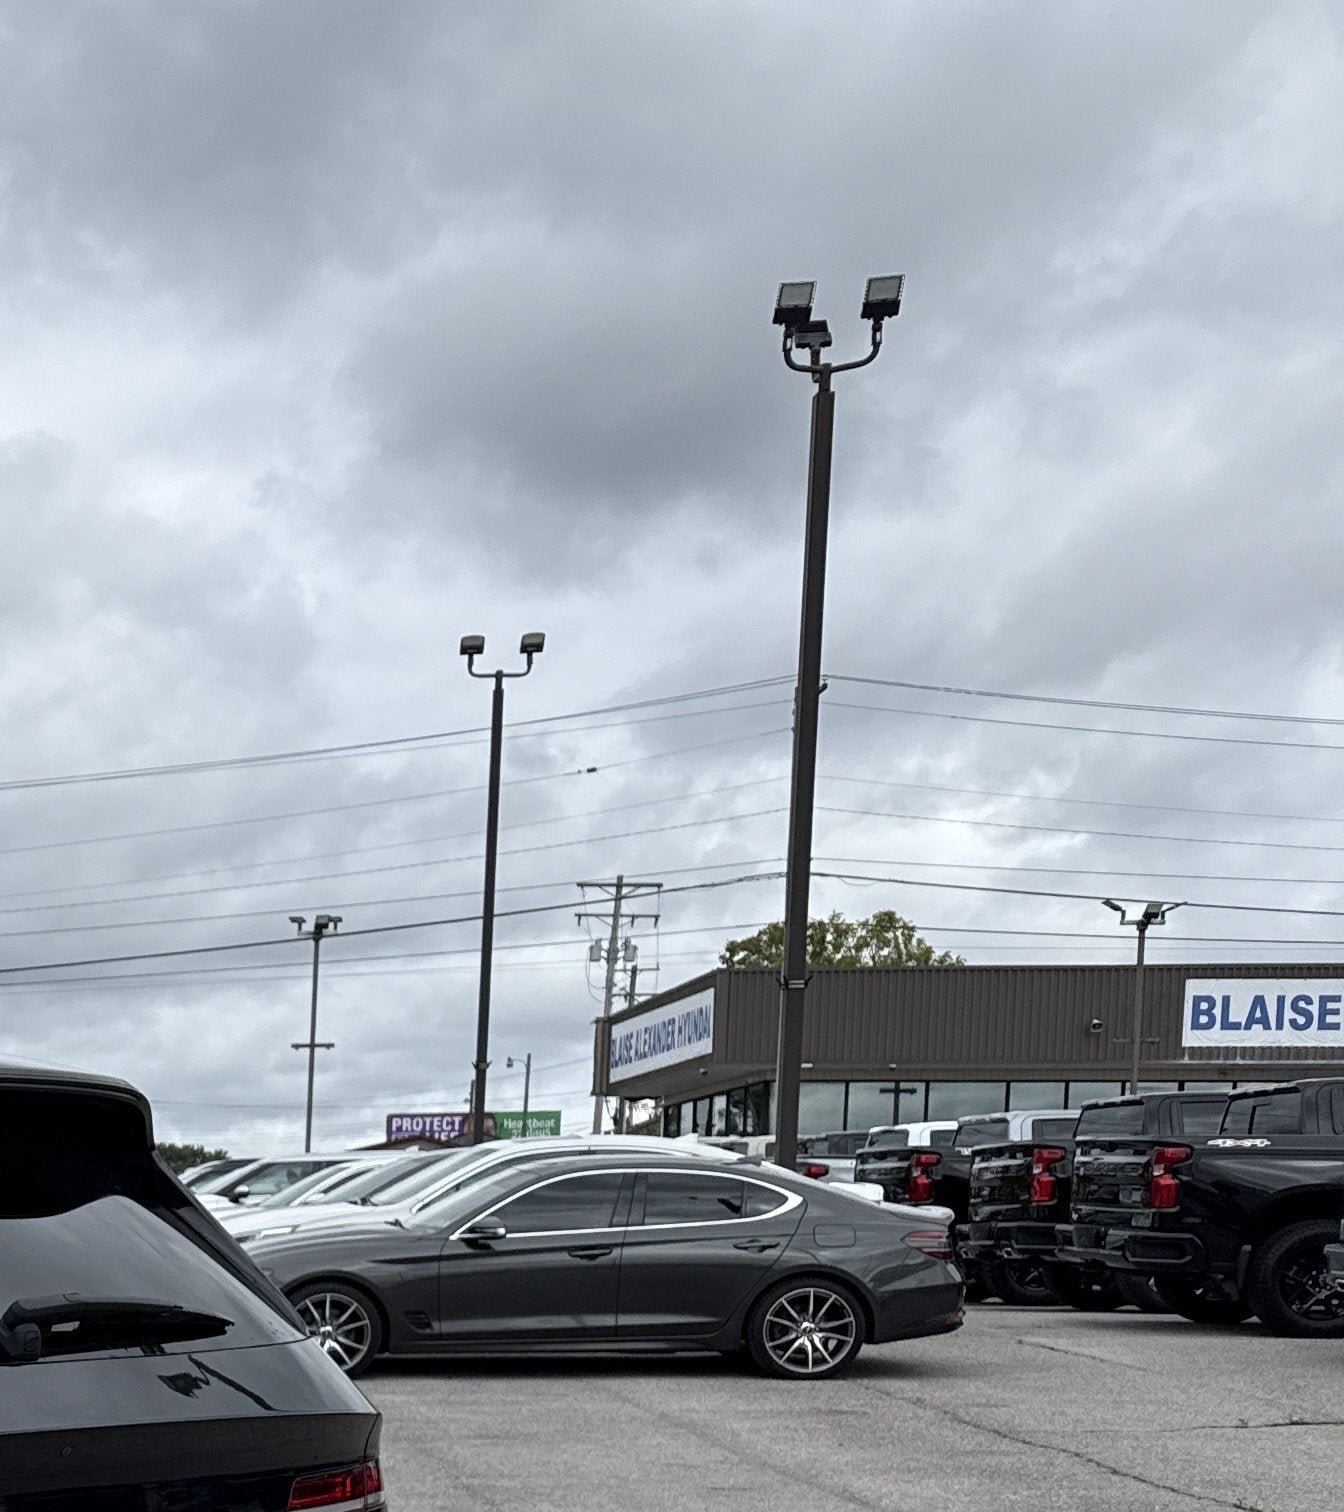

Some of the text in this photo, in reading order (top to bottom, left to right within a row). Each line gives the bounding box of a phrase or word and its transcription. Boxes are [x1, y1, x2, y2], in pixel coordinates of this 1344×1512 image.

[1191, 994, 1342, 1031] BLAISE
[634, 1017, 676, 1062] ALEXANDER
[676, 1003, 711, 1049] HYUNDAI
[391, 1116, 463, 1132] PROTECT
[503, 1118, 556, 1130] Heatbeat
